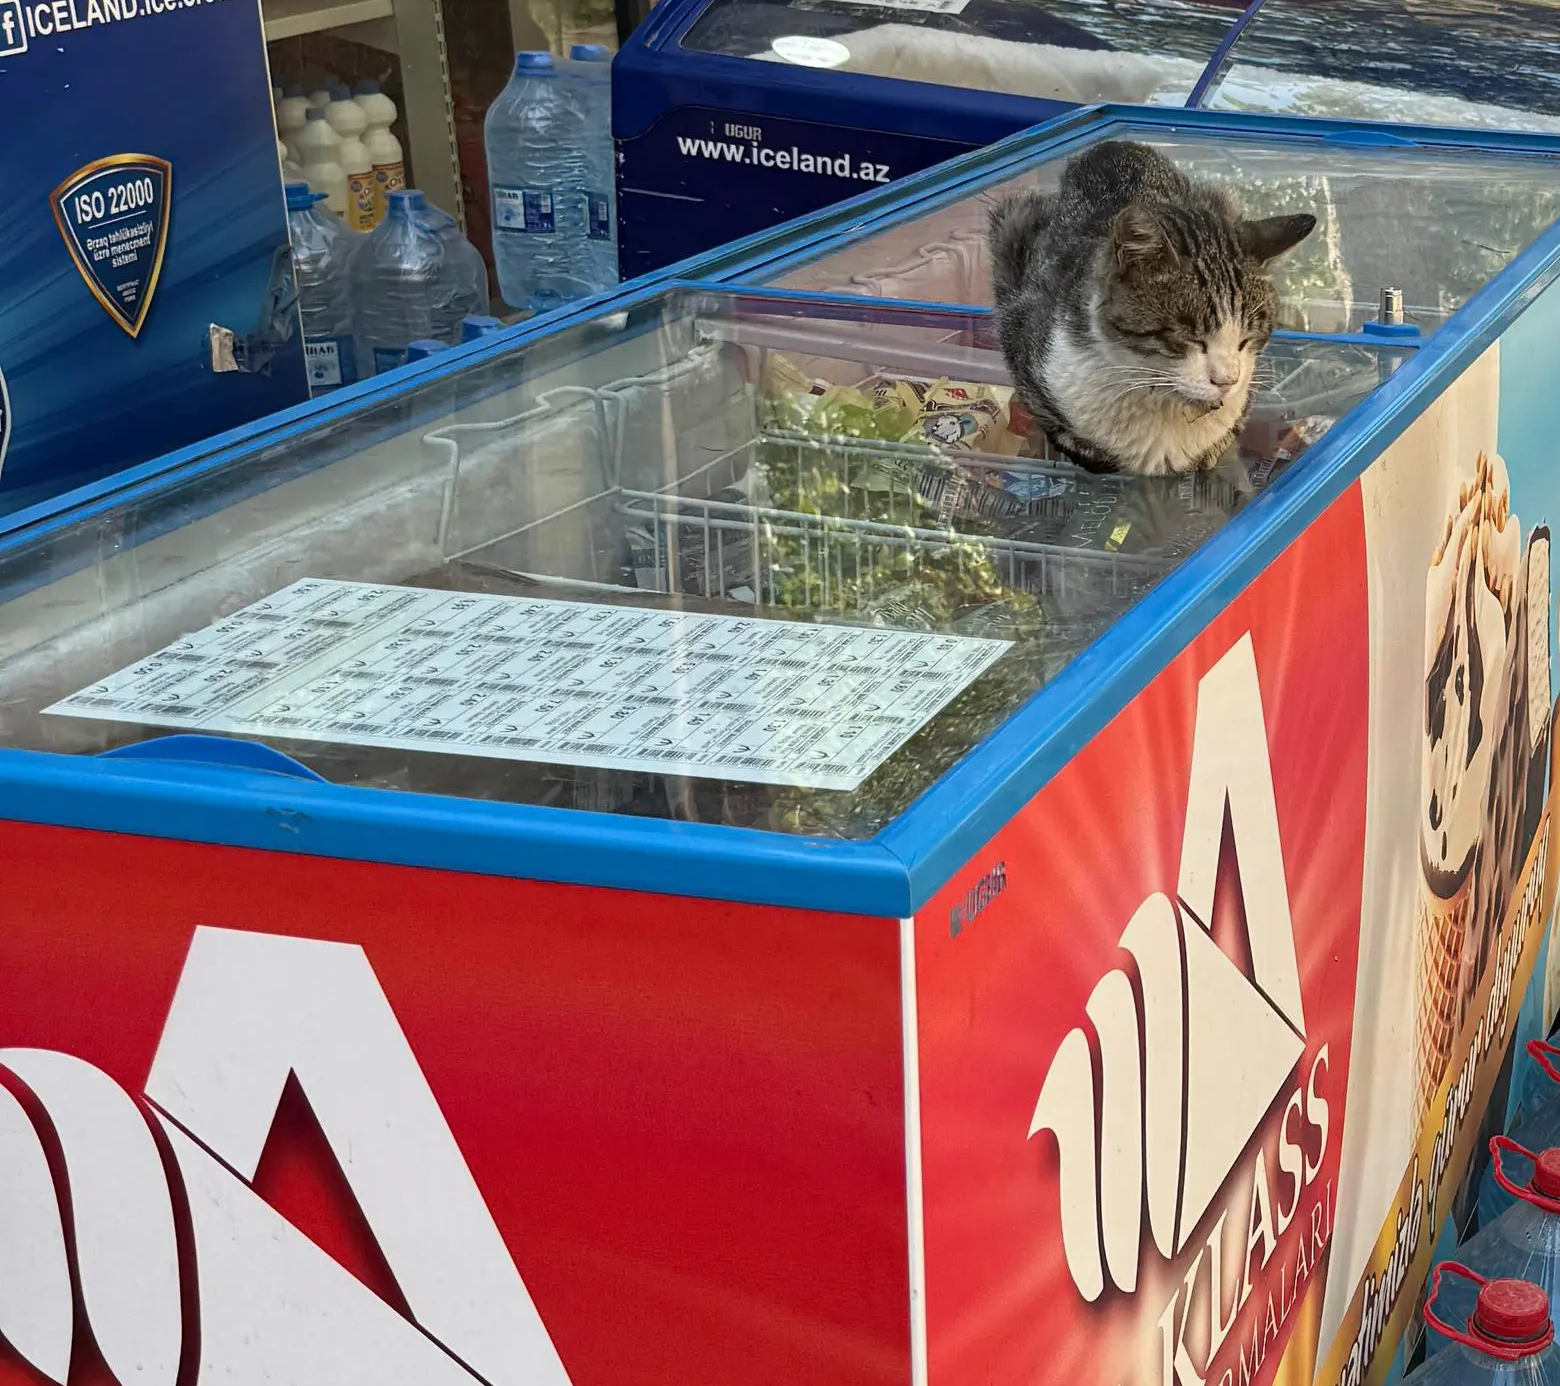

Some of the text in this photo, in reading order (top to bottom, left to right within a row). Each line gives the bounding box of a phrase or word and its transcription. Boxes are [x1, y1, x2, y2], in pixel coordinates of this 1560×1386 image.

[677, 136, 891, 183] www.iceland.az
[75, 177, 155, 225] ISO 22000
[112, 252, 138, 269] sistemi
